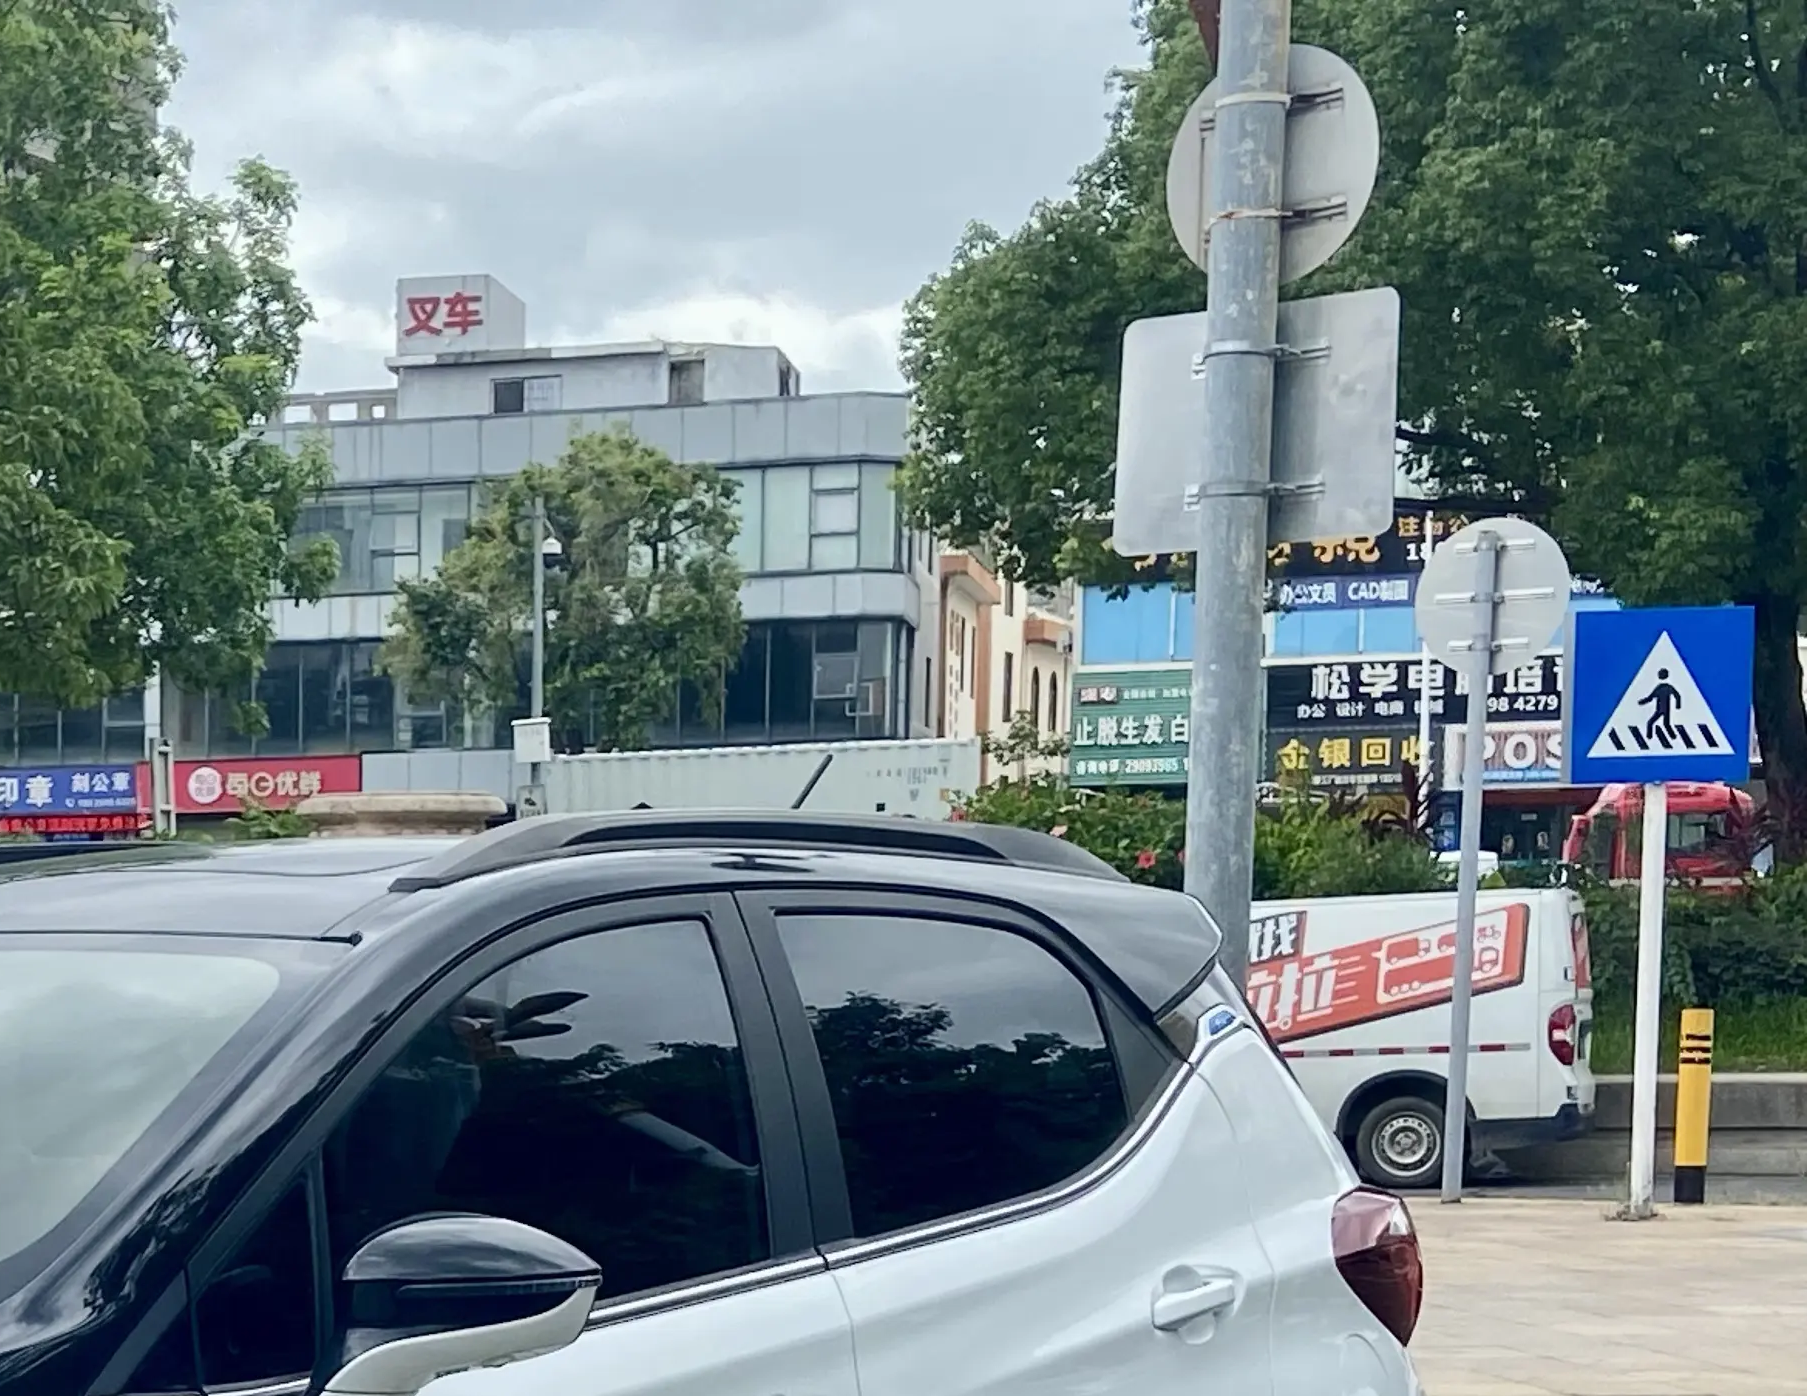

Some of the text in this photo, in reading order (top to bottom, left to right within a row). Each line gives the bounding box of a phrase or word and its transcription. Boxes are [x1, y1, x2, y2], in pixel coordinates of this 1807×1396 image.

[403, 291, 484, 337] 叉车
[1335, 701, 1366, 717] 设计
[1513, 694, 1559, 711] 4279
[1073, 713, 1190, 746] 止脱生发白
[71, 771, 131, 793] 刻公章
